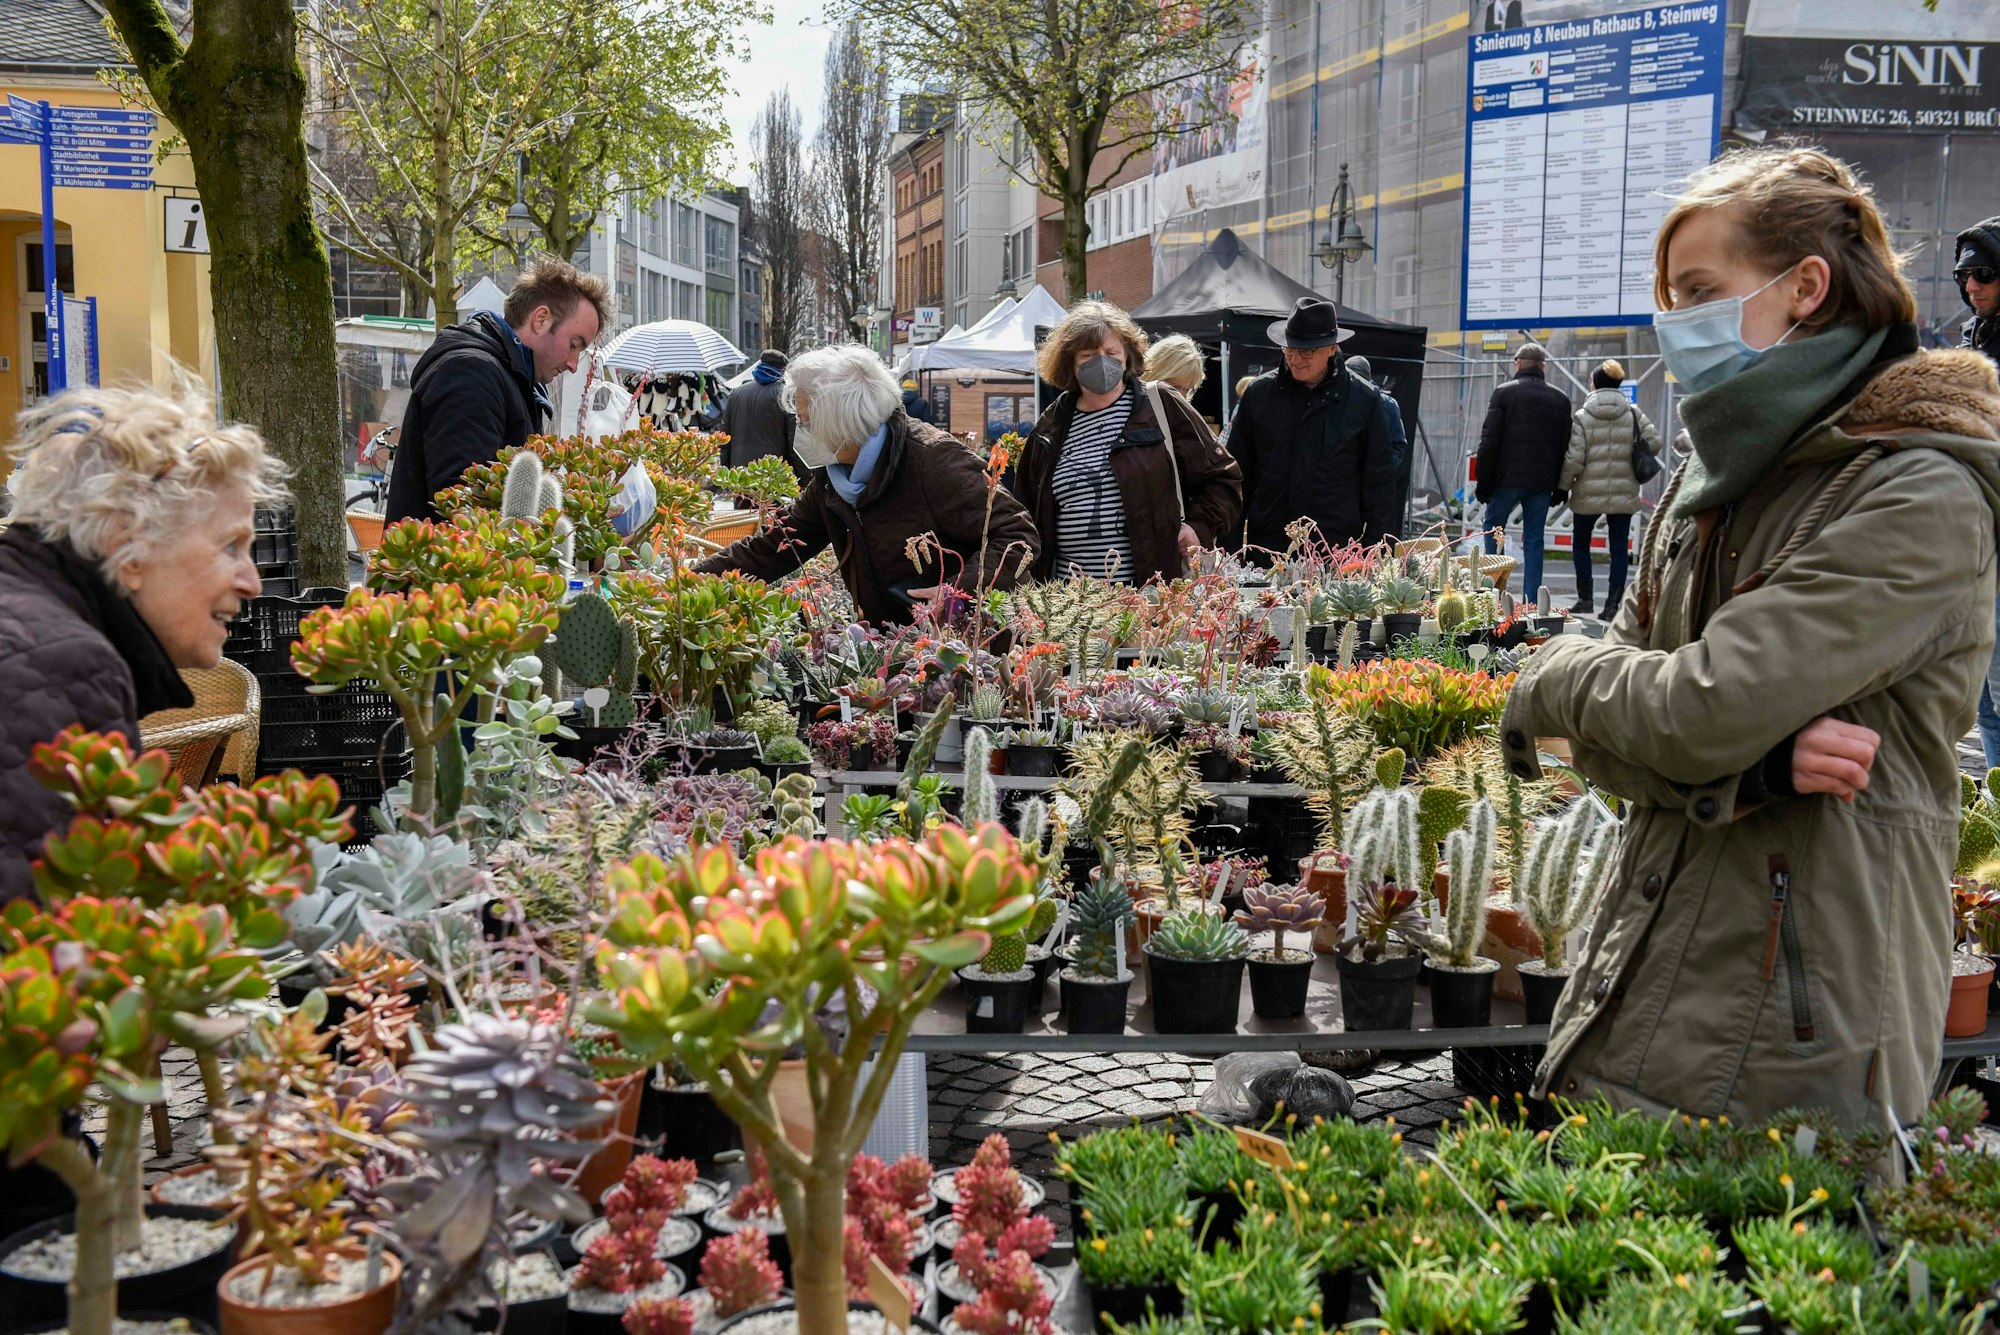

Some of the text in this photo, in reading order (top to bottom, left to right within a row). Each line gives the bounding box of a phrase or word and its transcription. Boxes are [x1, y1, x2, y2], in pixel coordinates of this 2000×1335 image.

[1475, 4, 1718, 53] Sanierung & Neubau Rathaus B, Steinweg
[1819, 58, 1839, 71] das
[1842, 43, 1985, 87] SiNN
[1805, 73, 1837, 83] macht
[60, 110, 98, 120] Amtsgericht
[1793, 107, 1885, 124] STEINWEG
[1889, 109, 1912, 127] 26,
[1915, 109, 1959, 126] 50321
[52, 124, 118, 134] Balth.-Neumann-Platz
[71, 138, 88, 146] Brühl
[89, 139, 106, 147] Mitte
[53, 150, 100, 160] Stadtbibliothek
[63, 165, 108, 175] Marienhospital
[63, 178, 105, 188] Mühlenstraße
[179, 203, 200, 249] i
